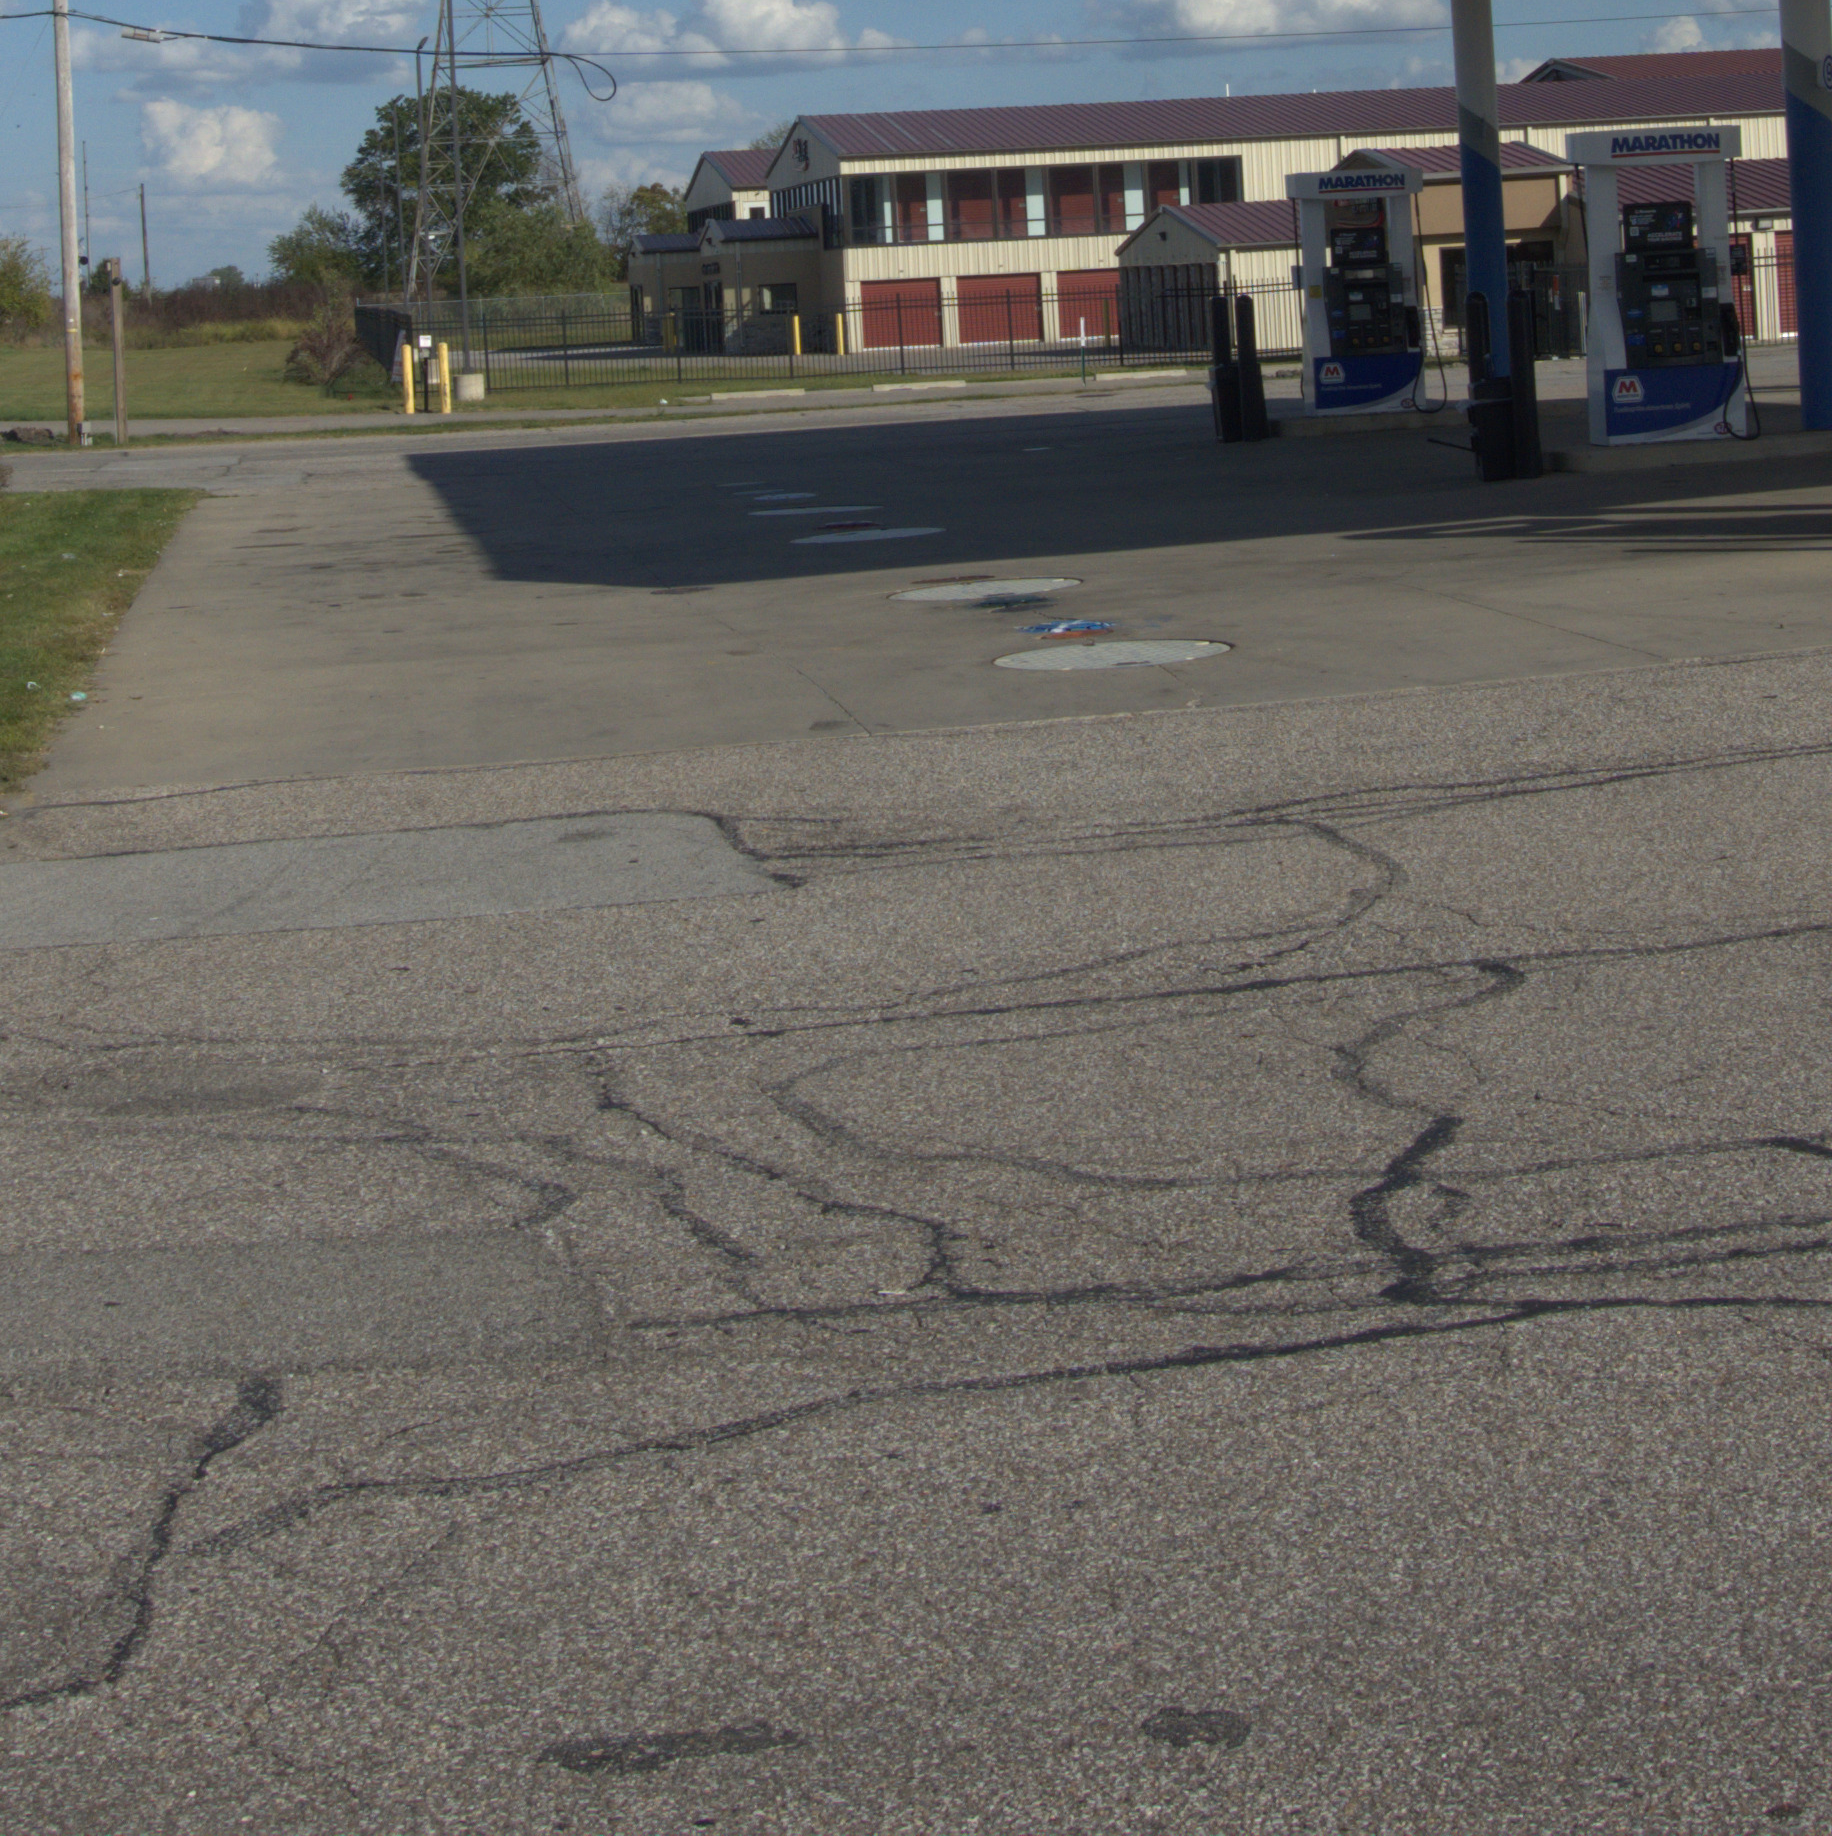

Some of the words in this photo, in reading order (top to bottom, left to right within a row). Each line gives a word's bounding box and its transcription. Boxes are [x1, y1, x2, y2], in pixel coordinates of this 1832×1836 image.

[1611, 133, 1720, 153] MARATHON
[1318, 174, 1405, 190] MARATHON
[1325, 366, 1340, 376] M
[1618, 380, 1638, 393] M
